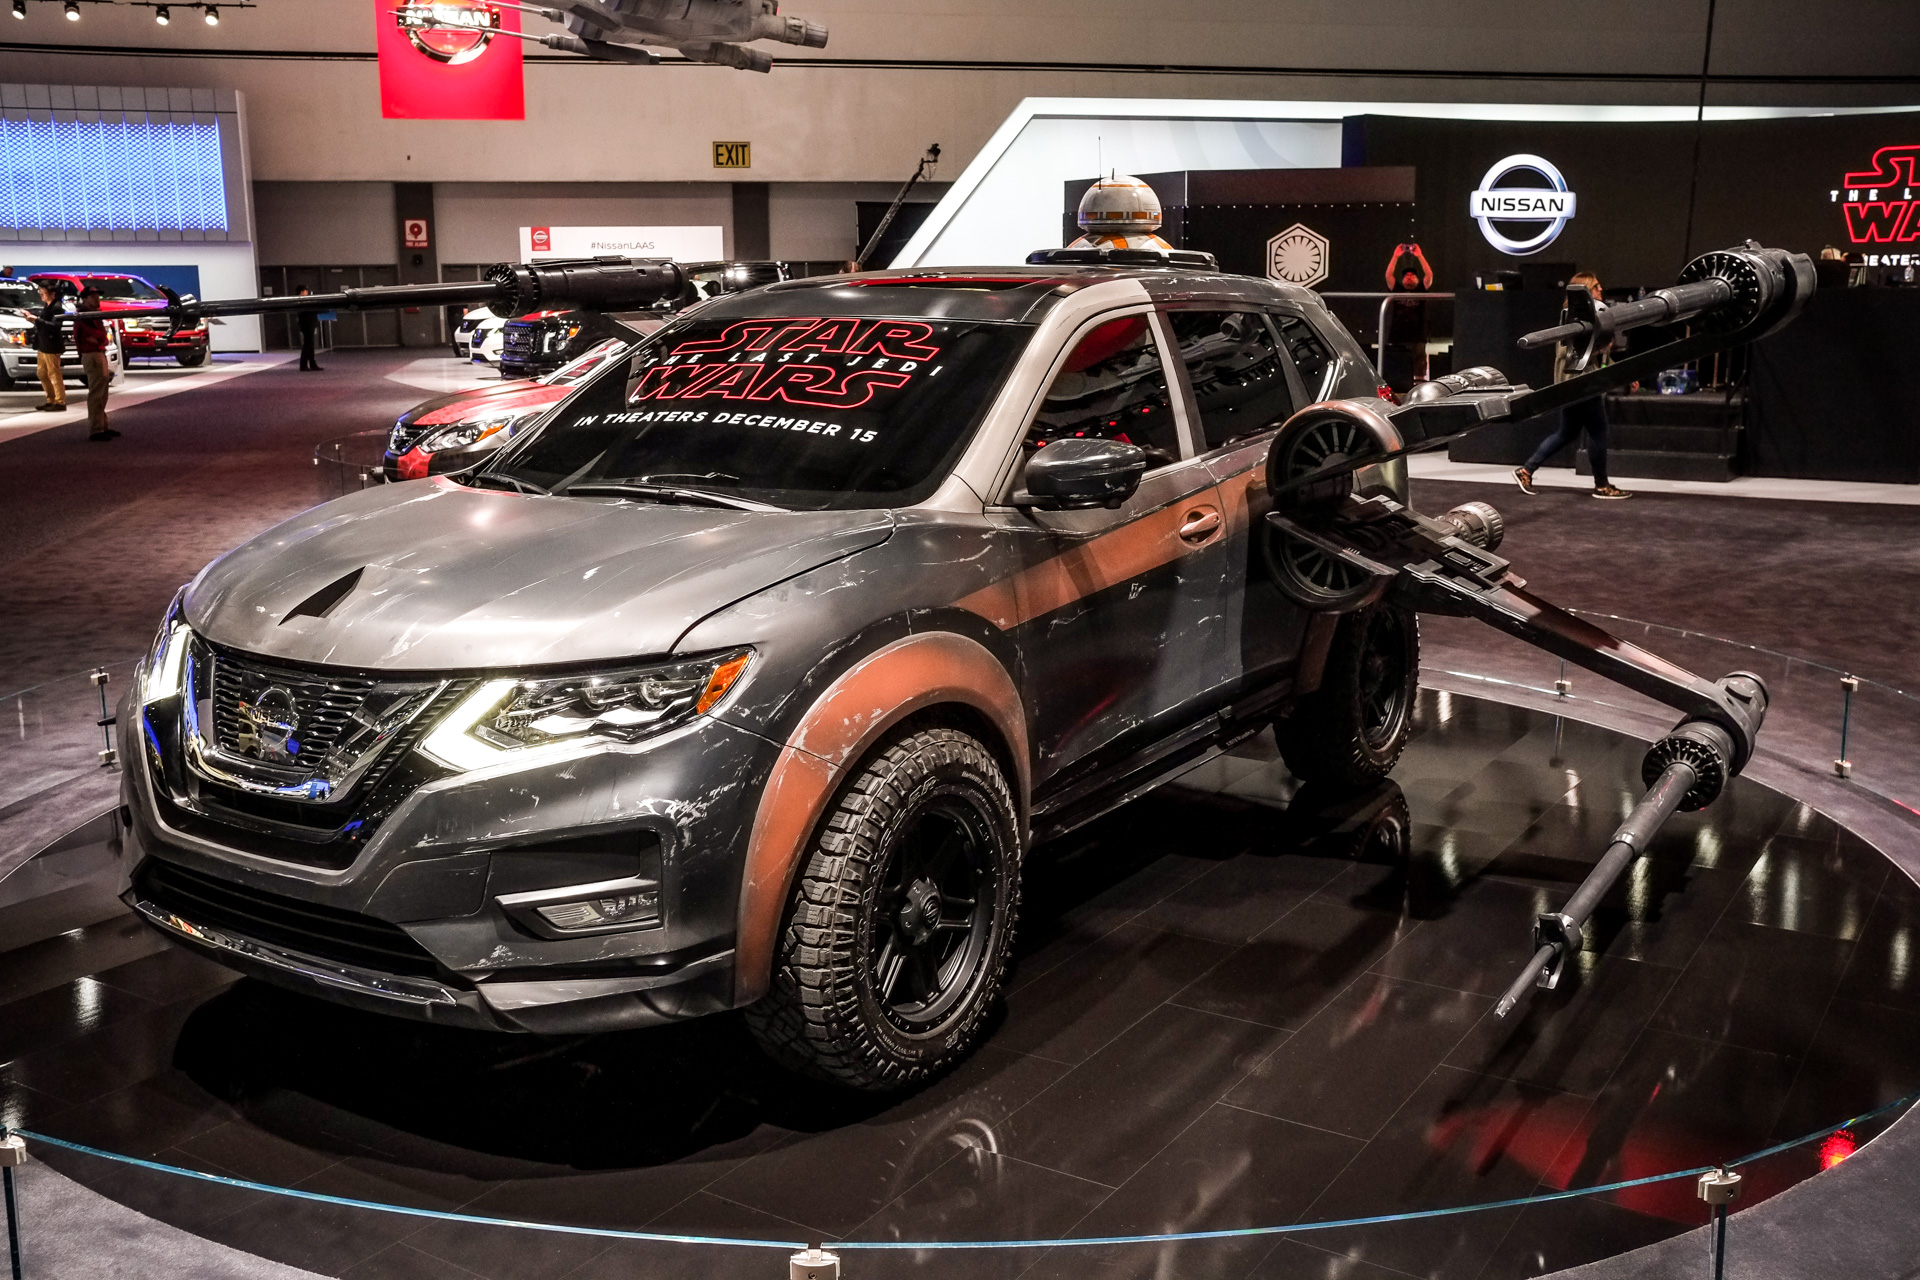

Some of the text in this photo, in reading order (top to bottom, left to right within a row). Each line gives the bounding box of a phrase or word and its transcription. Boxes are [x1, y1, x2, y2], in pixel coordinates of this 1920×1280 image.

[405, 9, 491, 27] NIAN
[715, 144, 748, 166] EXIT
[1481, 197, 1564, 212] NISSAN
[1829, 189, 1879, 202] THE
[590, 241, 655, 250] #NissanLAAS
[1863, 254, 1920, 266] EATER
[670, 318, 940, 361] STAR
[643, 352, 944, 377] THE LAST JEDI
[628, 363, 912, 410] WARS
[573, 411, 879, 443] IN THEATERS DECEMBER 15
